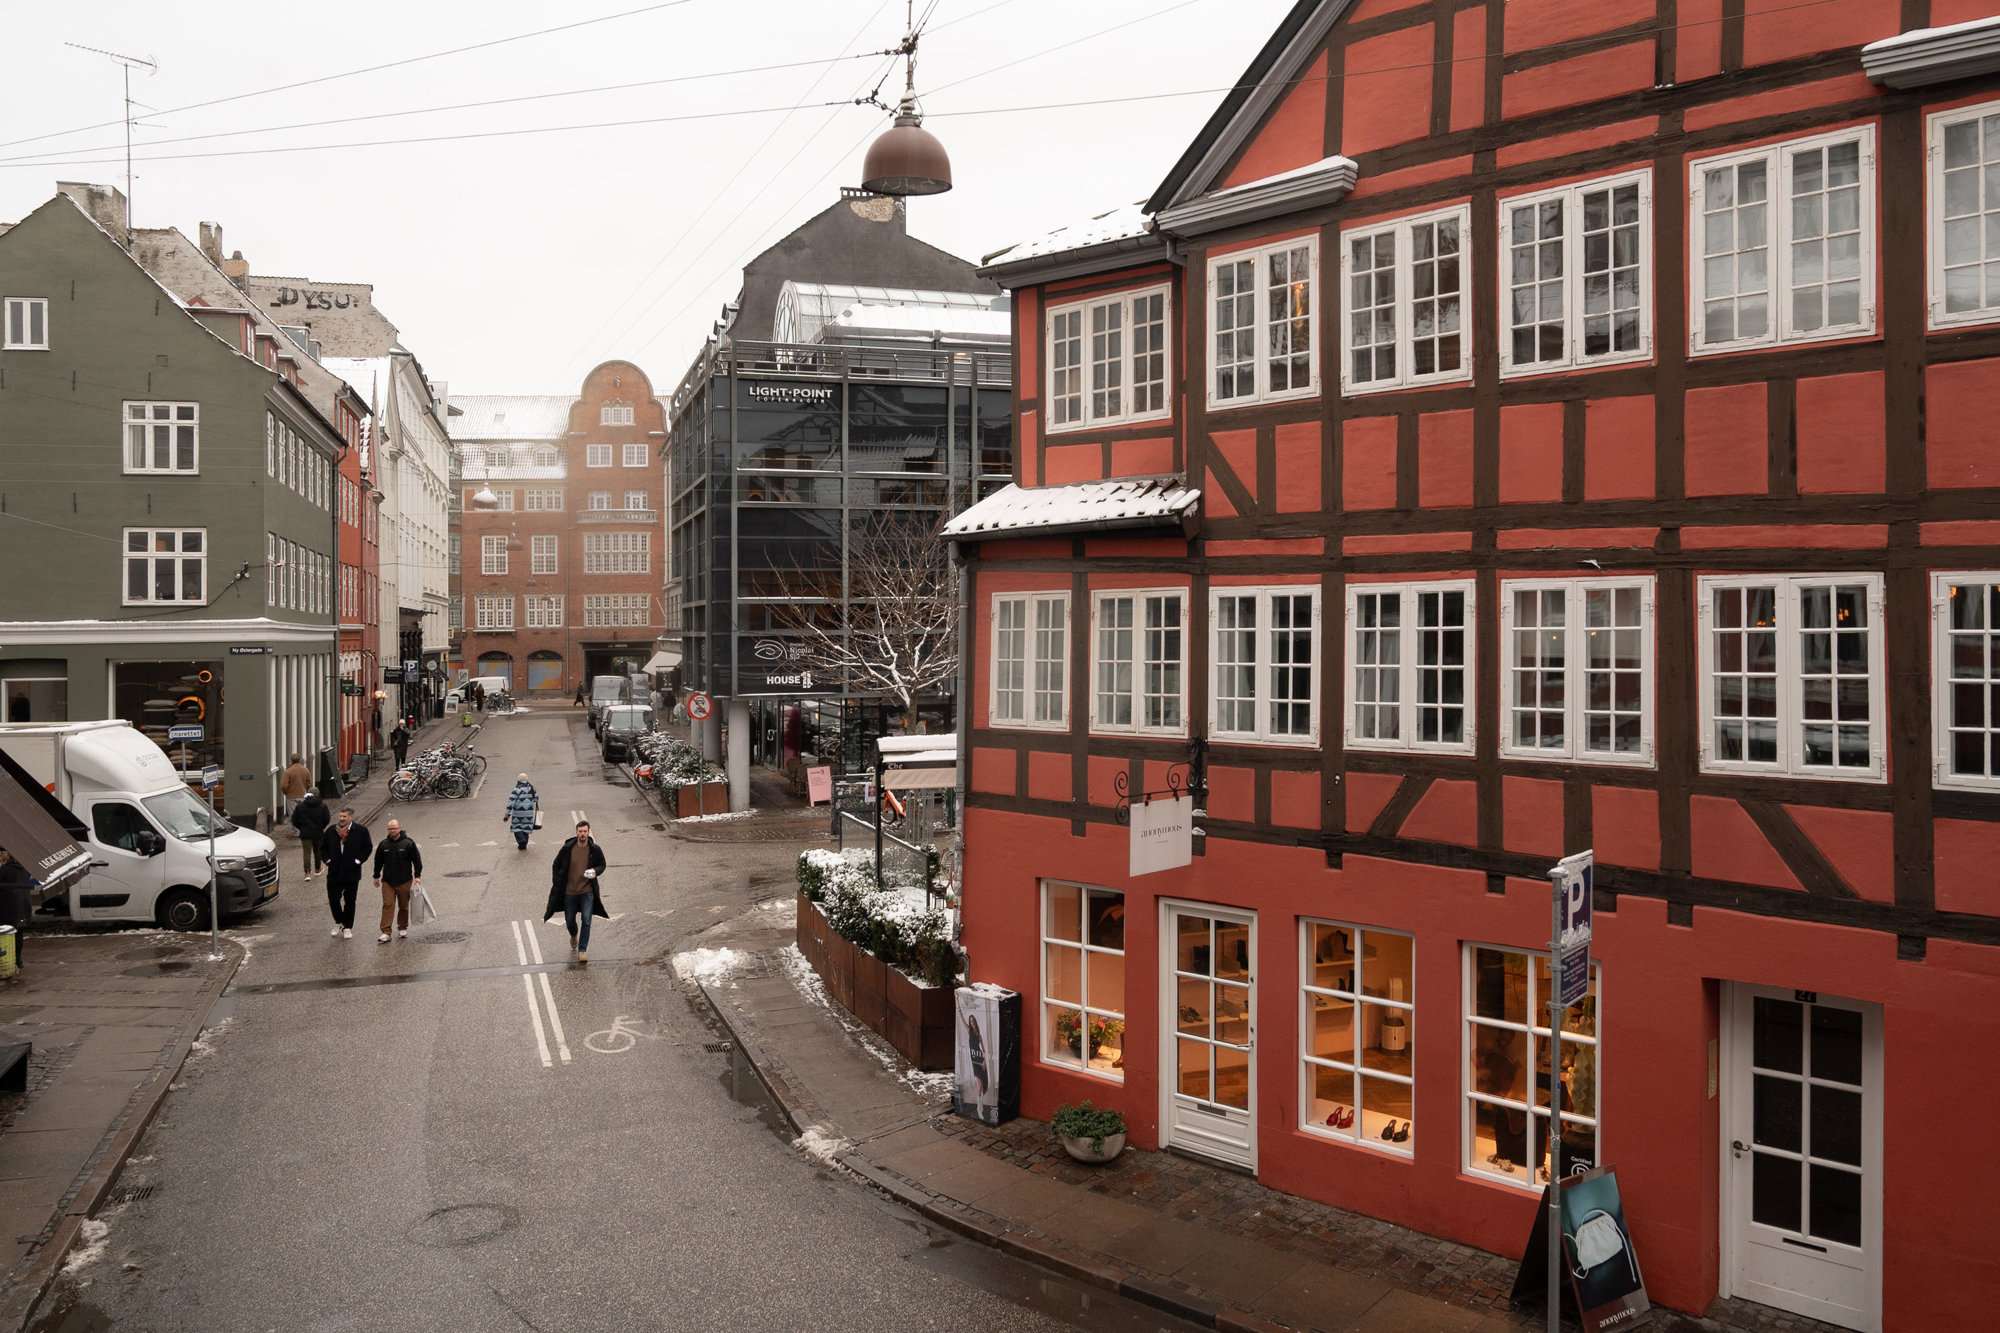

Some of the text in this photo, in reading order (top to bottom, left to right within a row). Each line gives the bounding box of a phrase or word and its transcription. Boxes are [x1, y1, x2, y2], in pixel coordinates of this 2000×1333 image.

[756, 396, 825, 404] COPENHAGEN
[407, 661, 416, 672] P
[766, 675, 801, 685] HOUSE
[1570, 1156, 1592, 1165] Certified
[1599, 1306, 1636, 1328] anonymous
